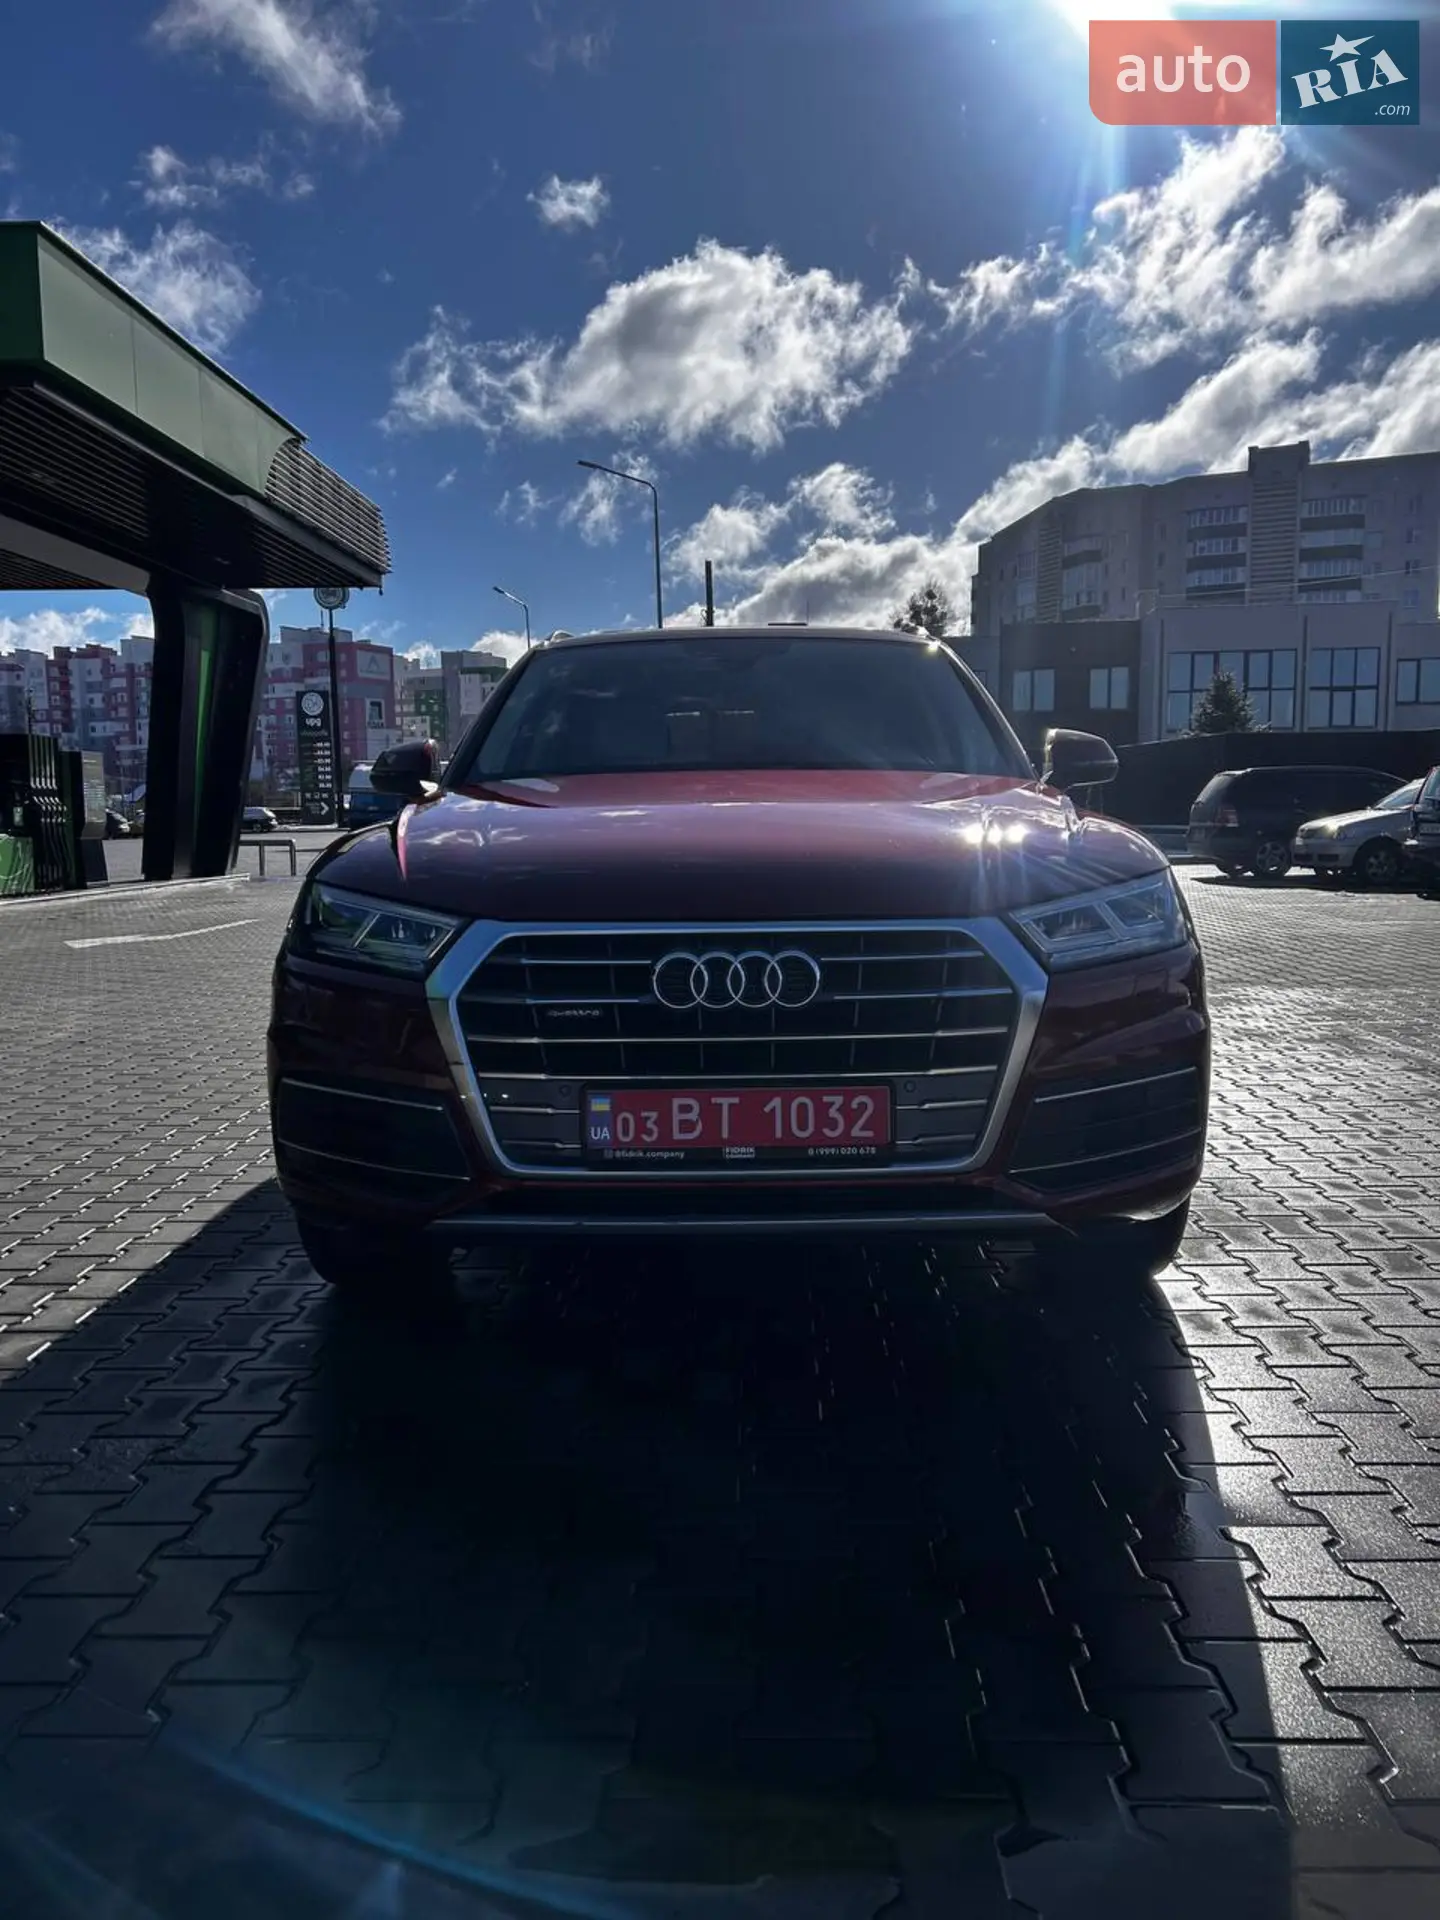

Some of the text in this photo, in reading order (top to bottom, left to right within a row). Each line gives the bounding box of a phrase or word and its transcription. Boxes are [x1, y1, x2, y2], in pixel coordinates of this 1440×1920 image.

[305, 718, 322, 727] upg
[616, 1095, 875, 1142] 03 BT 1032
[591, 1127, 610, 1140] UA
